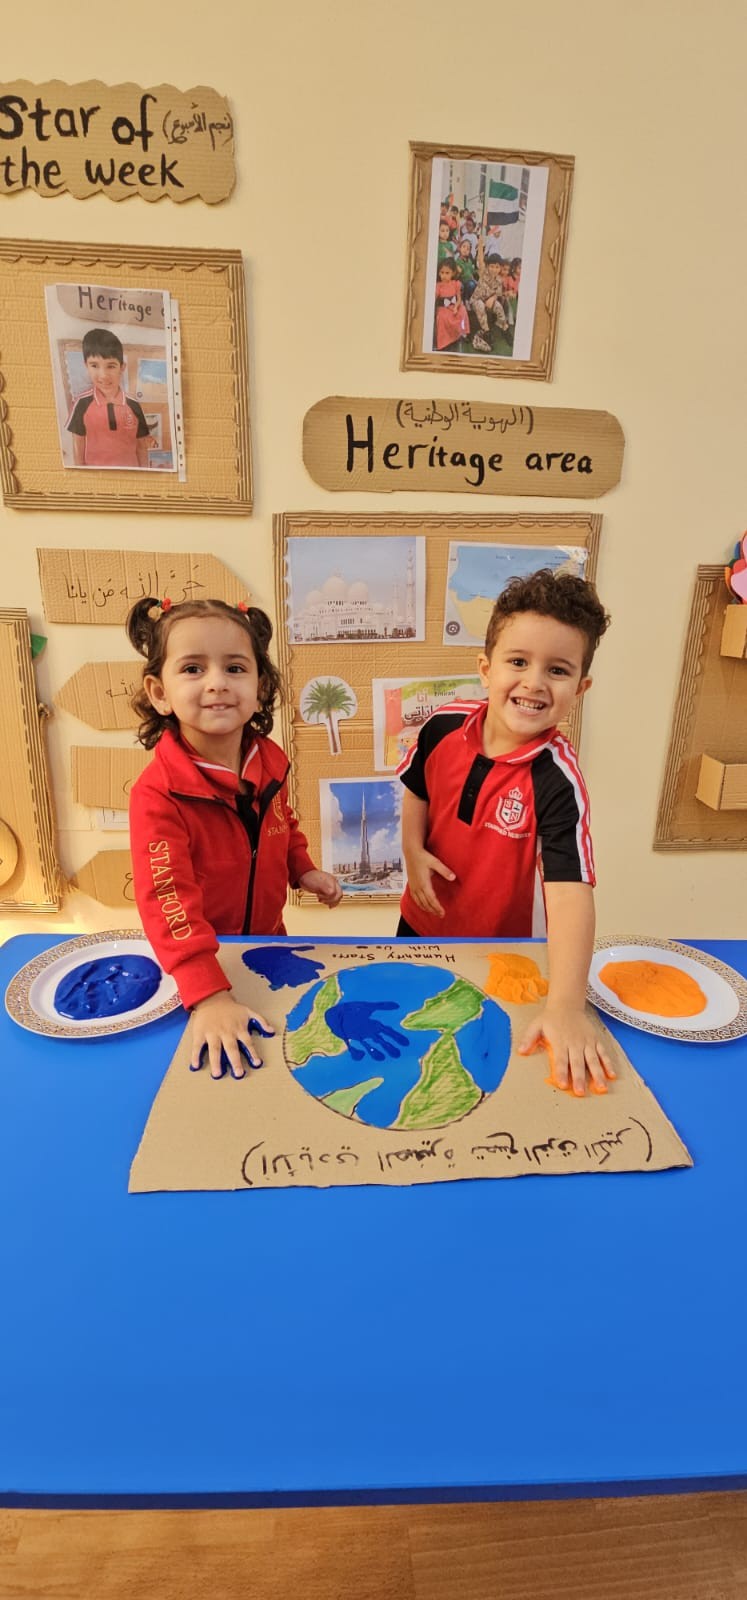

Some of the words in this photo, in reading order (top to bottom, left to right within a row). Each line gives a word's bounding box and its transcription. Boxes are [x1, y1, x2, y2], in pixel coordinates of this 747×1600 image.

[0, 95, 101, 141] Star
[112, 93, 158, 152] of
[0, 146, 67, 189] the
[85, 153, 185, 188] week
[78, 286, 152, 322] Heritage
[346, 413, 503, 486] Heritage
[525, 452, 593, 474] area
[148, 840, 193, 941] STANFORD
[387, 951, 456, 963] Humanity
